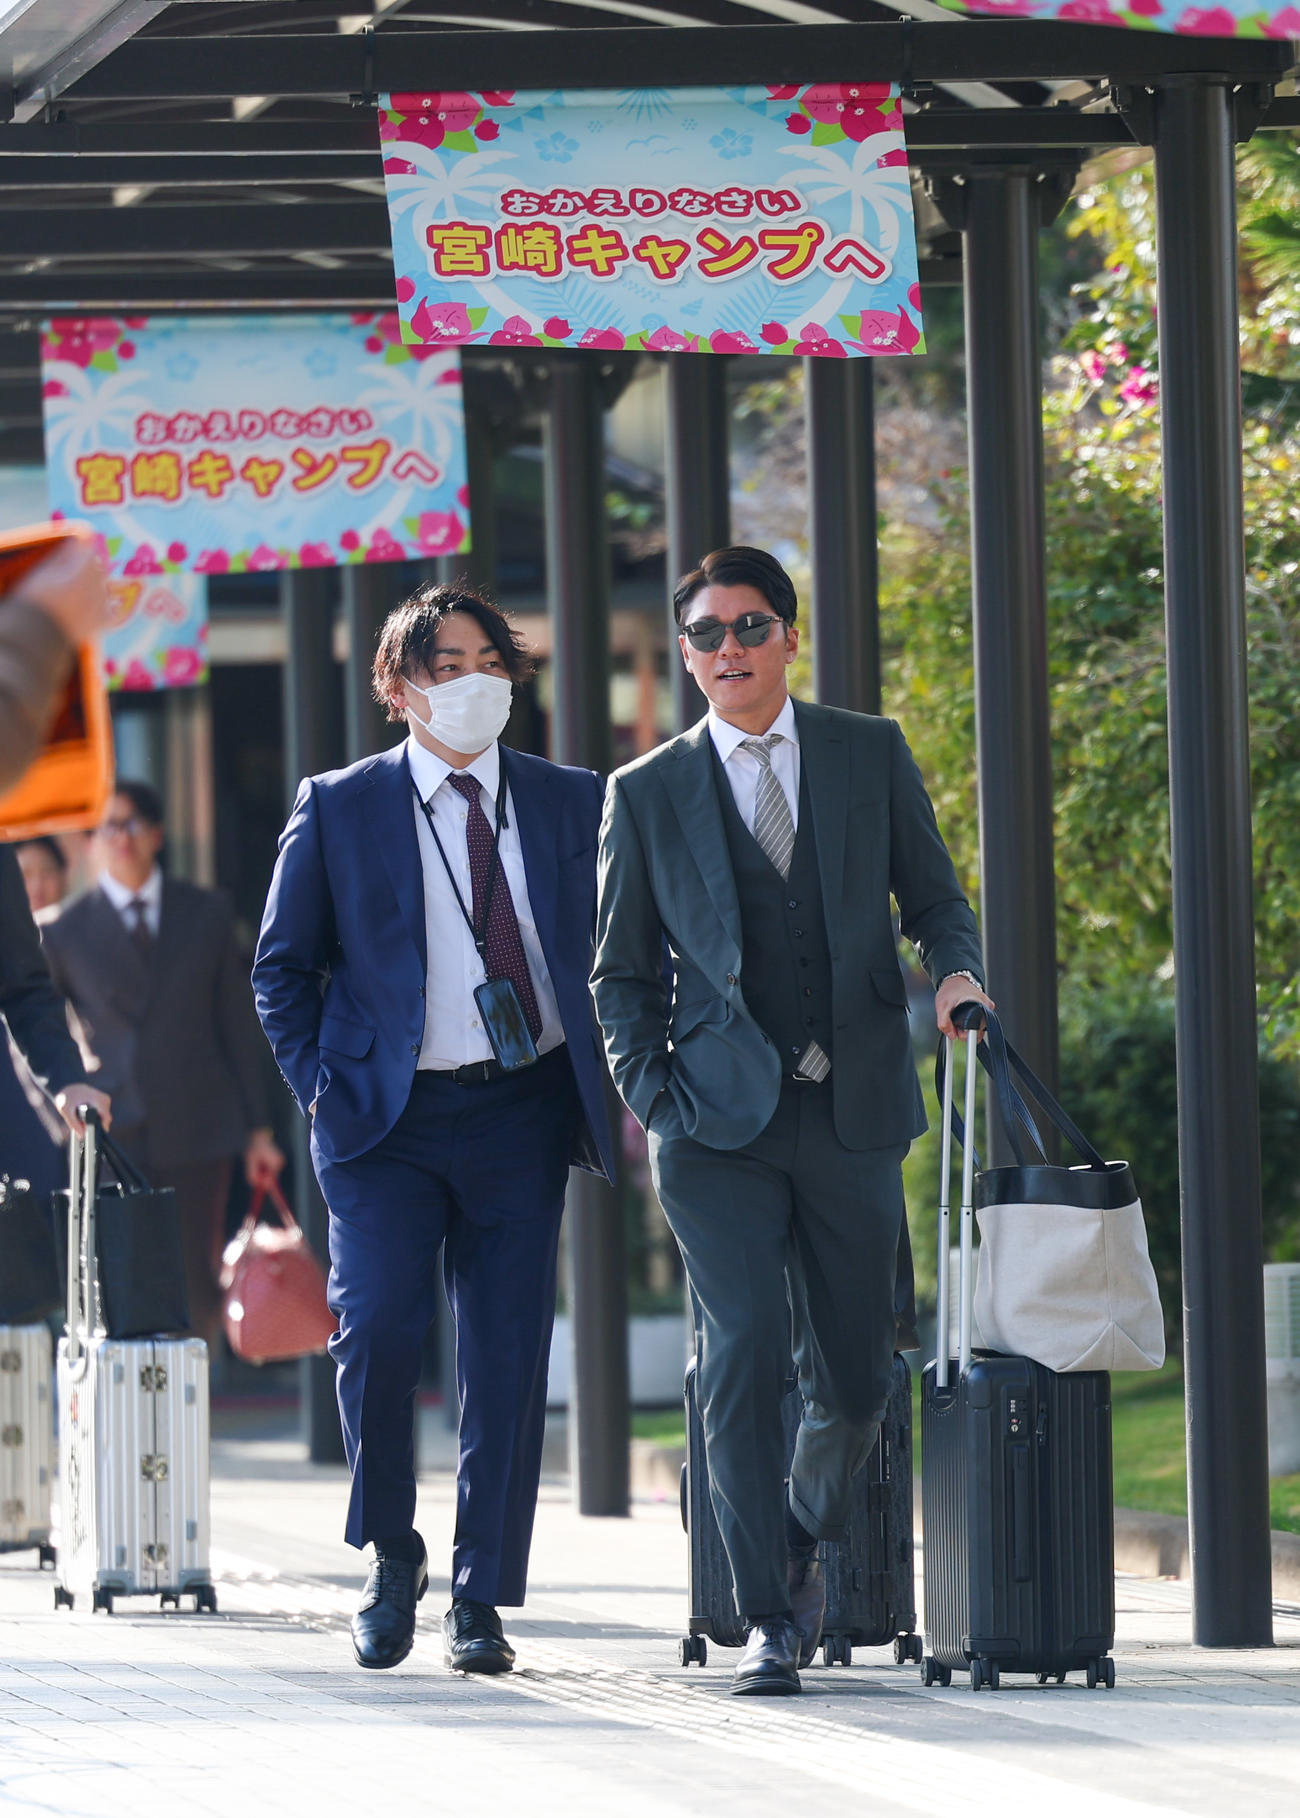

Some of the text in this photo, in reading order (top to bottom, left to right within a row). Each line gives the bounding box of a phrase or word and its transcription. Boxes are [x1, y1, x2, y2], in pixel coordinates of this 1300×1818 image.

[502, 188, 803, 217] おかえりなさい
[427, 222, 885, 278] 宮崎キャンプへ
[136, 408, 373, 443] おかえりなさい
[76, 439, 439, 504] 宮崎キャンプへ
